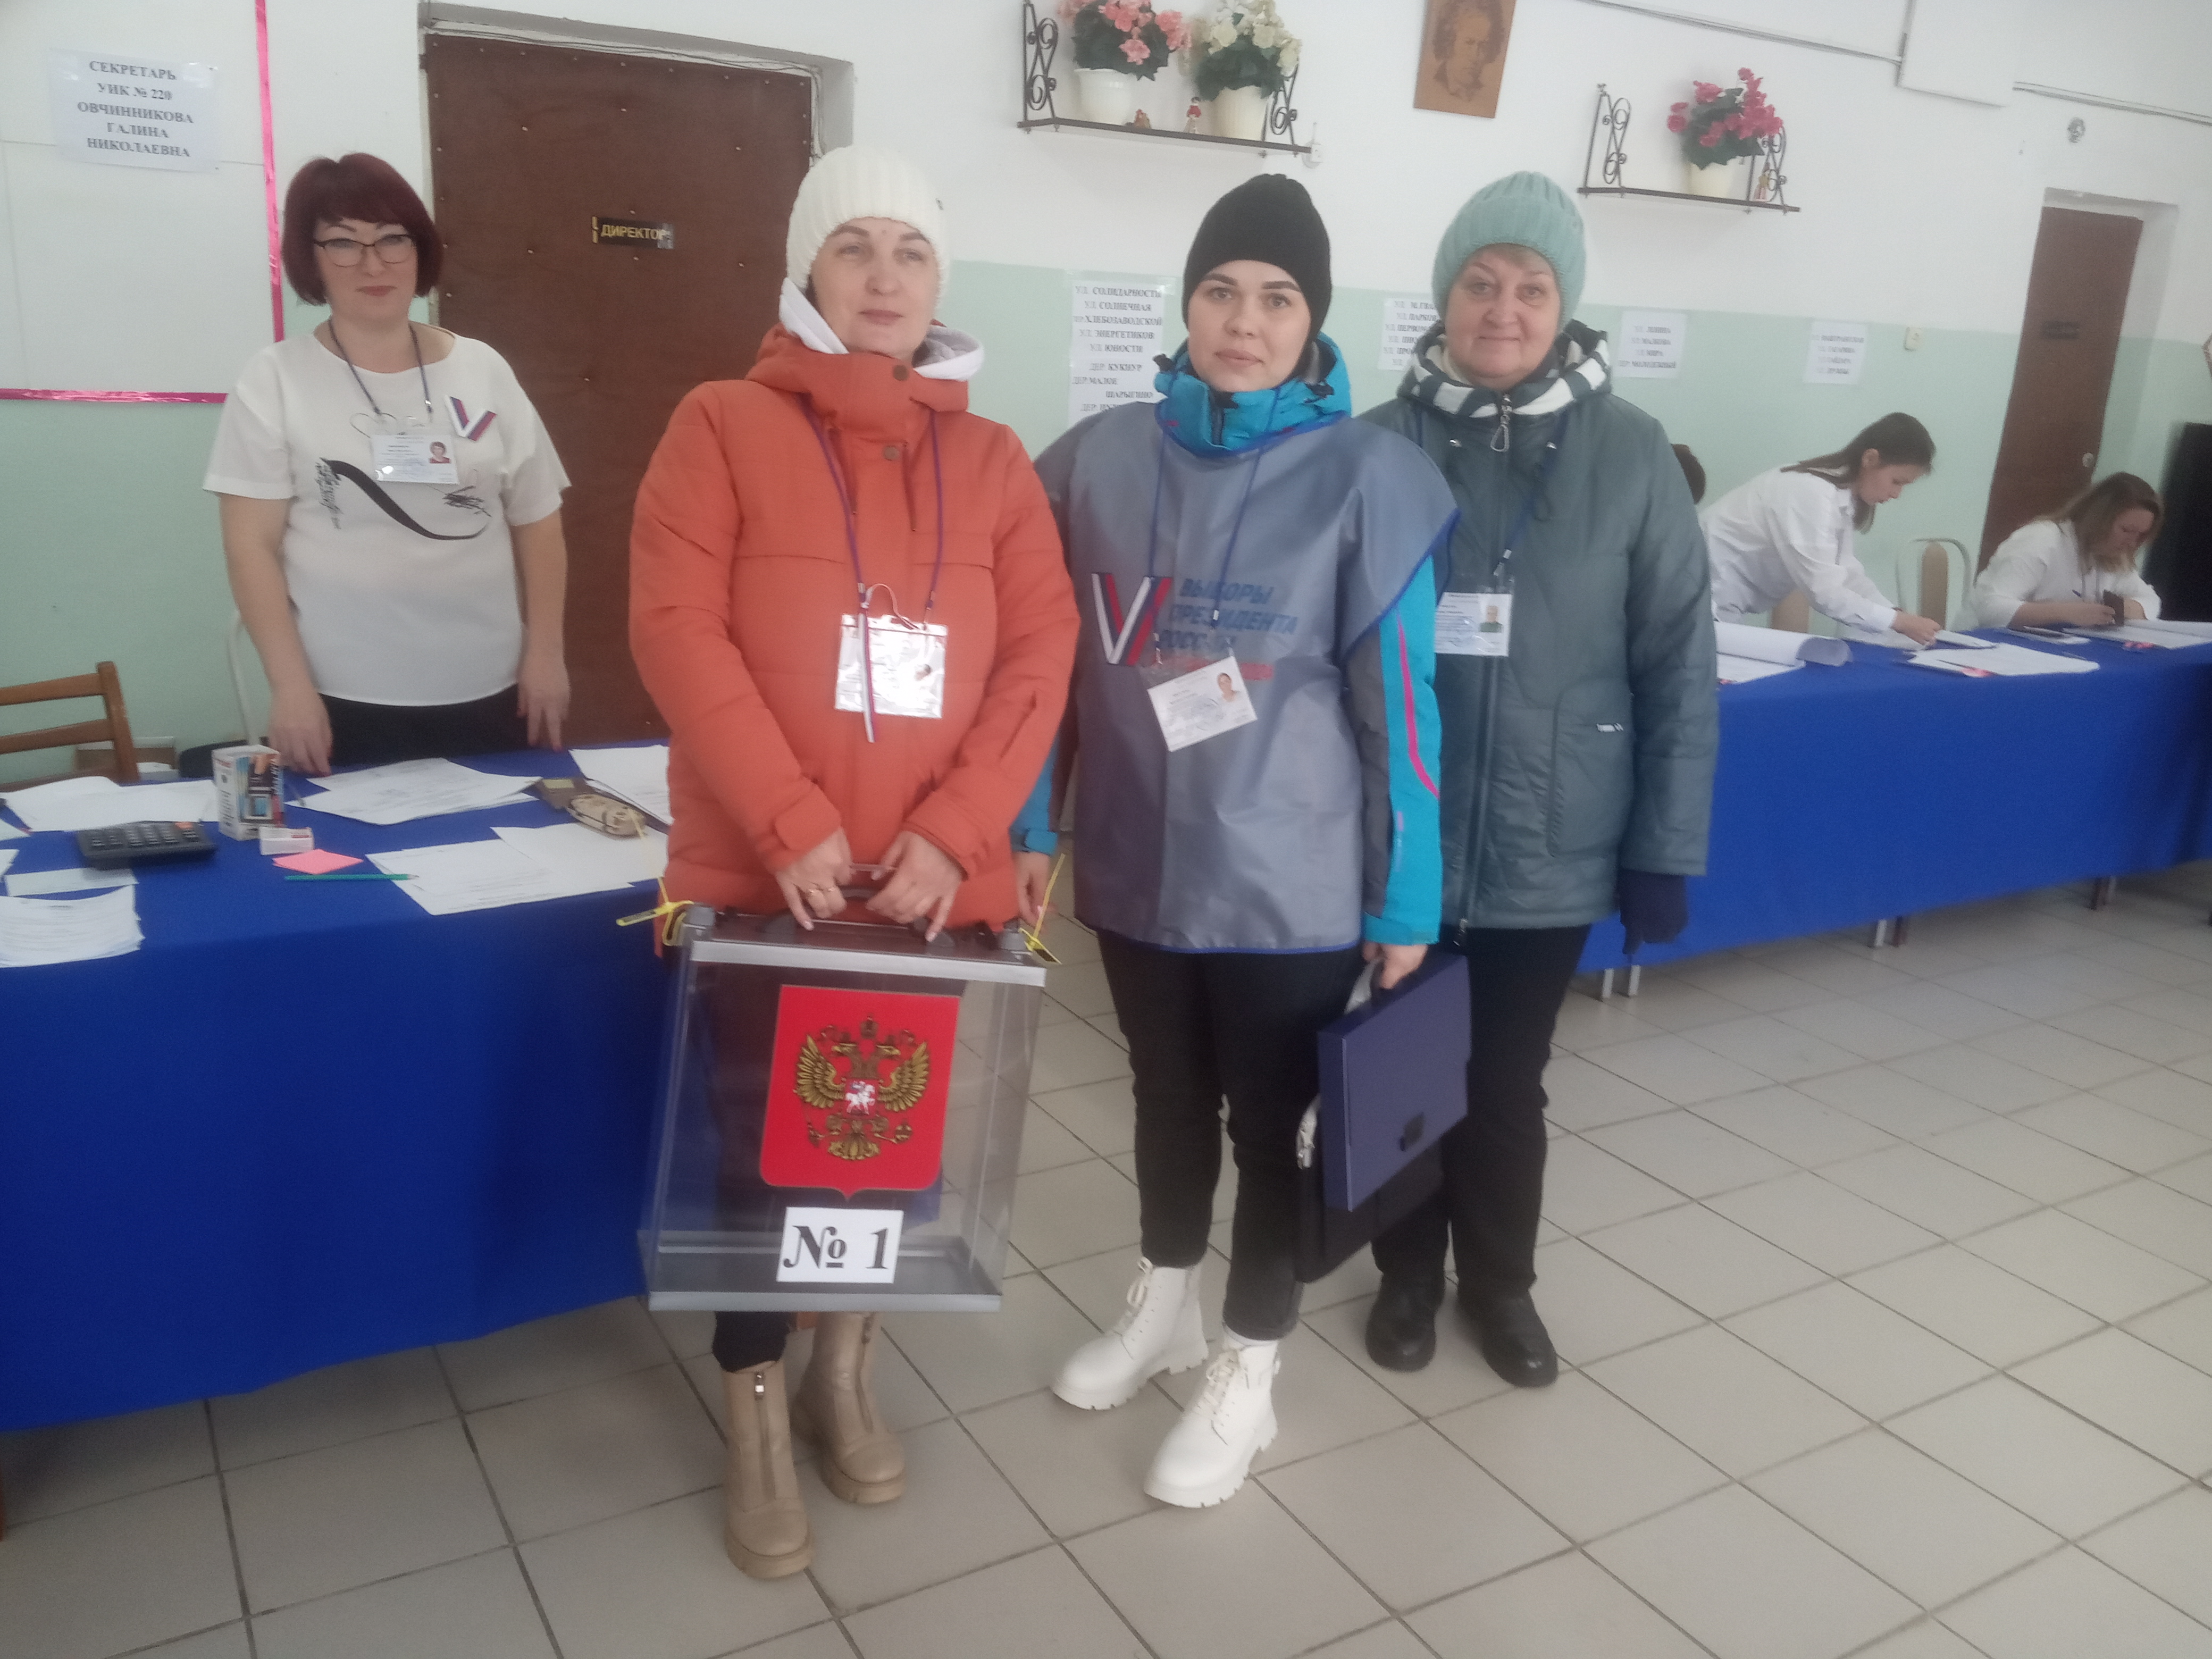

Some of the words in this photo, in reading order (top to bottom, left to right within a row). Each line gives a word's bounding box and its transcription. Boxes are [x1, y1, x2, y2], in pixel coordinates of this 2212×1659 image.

[89, 61, 177, 80] СЕКРЕТАРЬ
[77, 102, 194, 123] ОВЧИННИКОВА
[107, 122, 169, 138] ГАЛИНА
[87, 138, 191, 157] НИКОЛАЕВНА
[783, 1225, 848, 1269] №
[865, 1227, 889, 1270] 1
